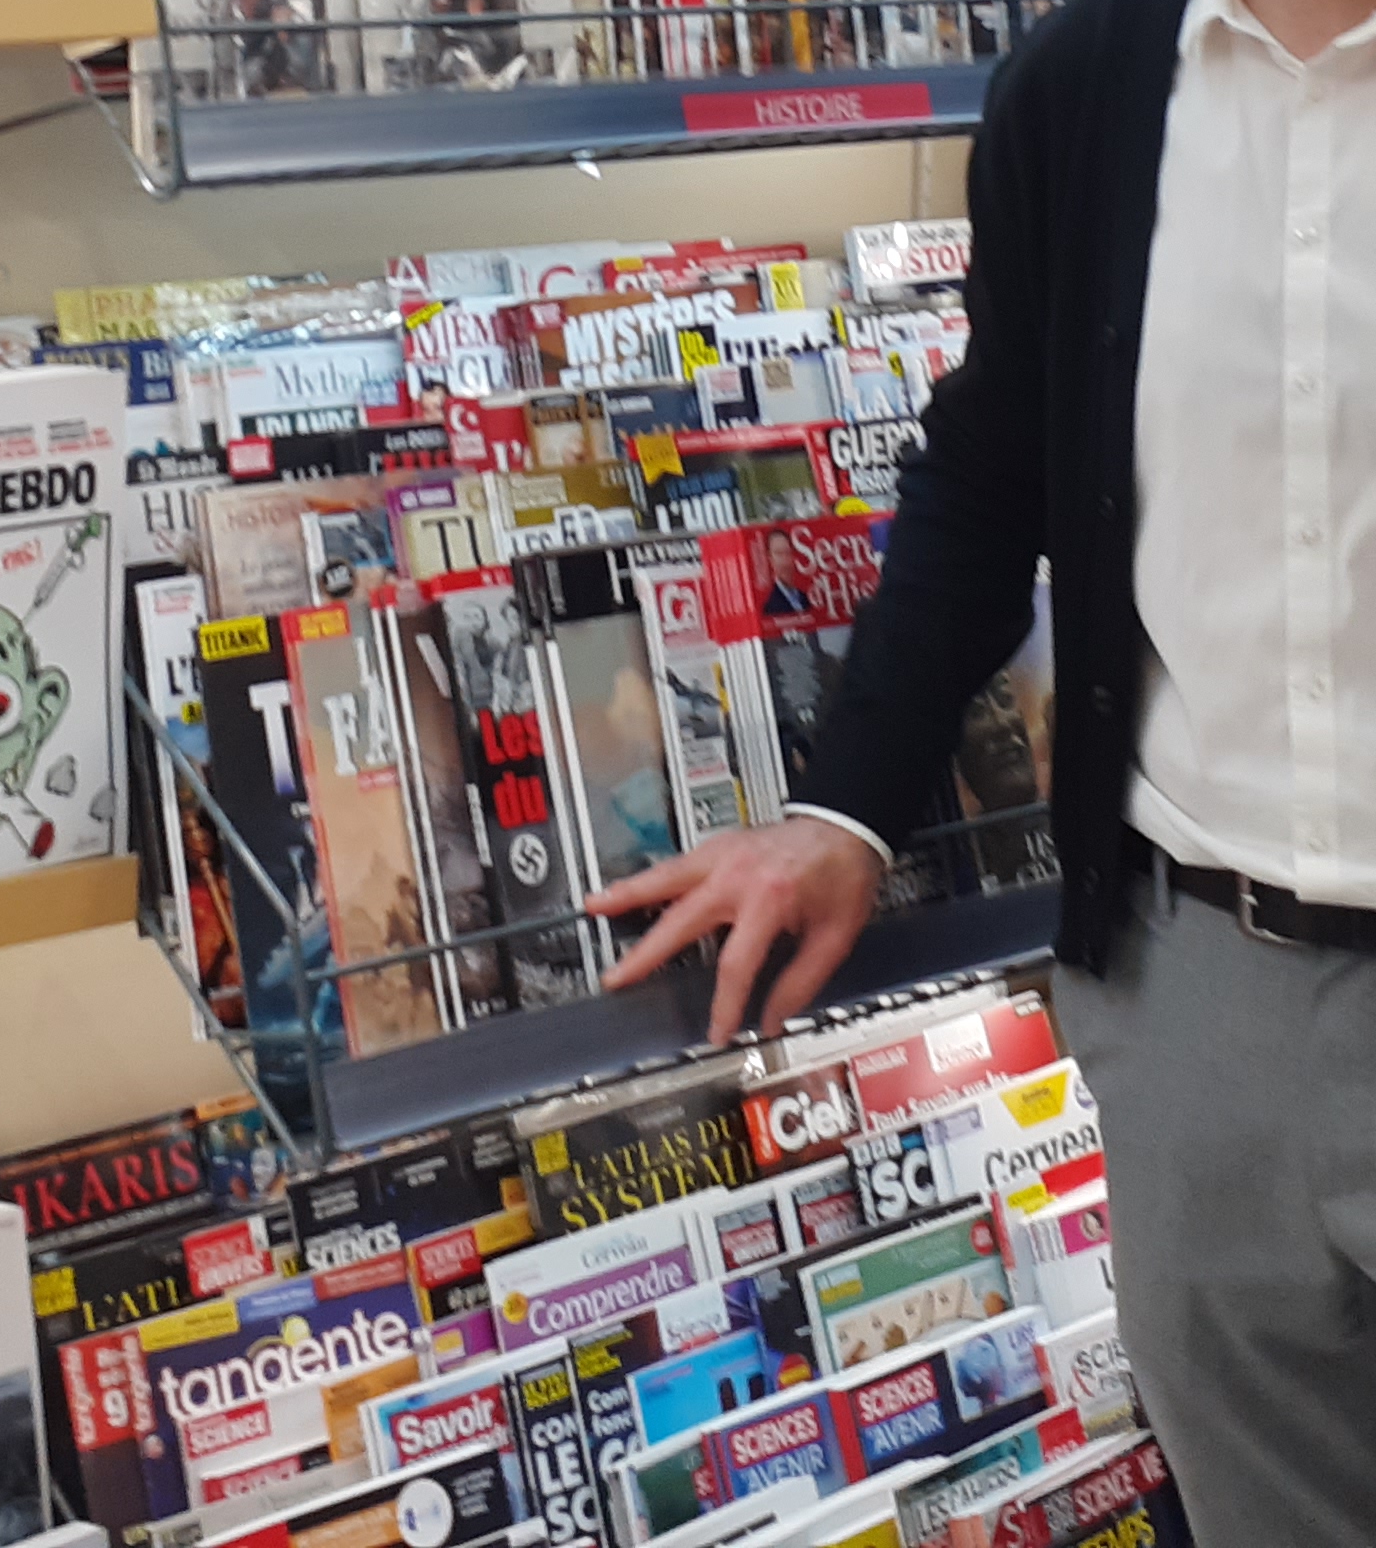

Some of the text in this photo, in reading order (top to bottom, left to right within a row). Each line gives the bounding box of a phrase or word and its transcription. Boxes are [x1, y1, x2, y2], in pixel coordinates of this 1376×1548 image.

[753, 91, 865, 127] HISTOIRE
[526, 1254, 687, 1336] Comprendre
[397, 1396, 496, 1454] Savoir
[732, 1406, 820, 1465] SCIENCES
